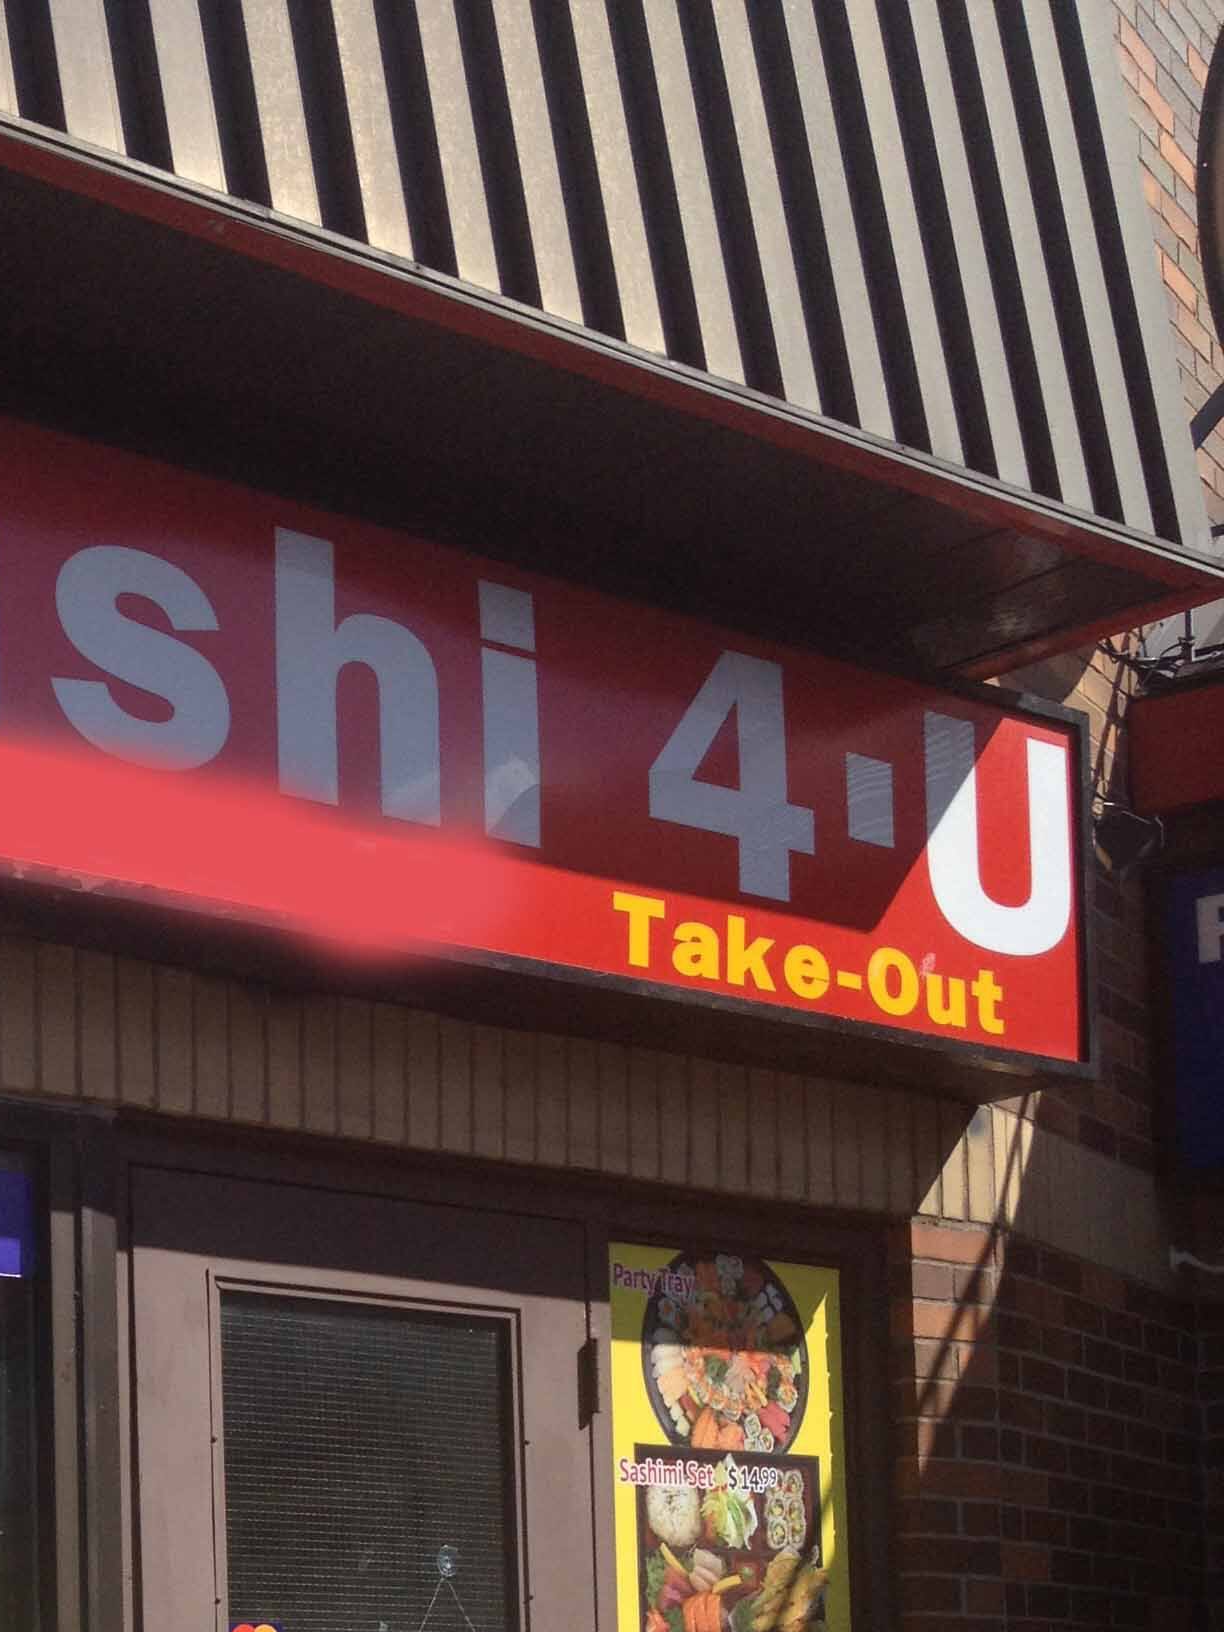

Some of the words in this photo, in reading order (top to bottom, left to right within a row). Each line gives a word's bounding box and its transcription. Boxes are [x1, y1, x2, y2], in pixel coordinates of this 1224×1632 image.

[613, 892, 1006, 1035] Take-Out
[613, 1263, 656, 1296] Party
[658, 1267, 696, 1296] Tray
[620, 1459, 683, 1485] Sashimi
[686, 1463, 714, 1488] Set
